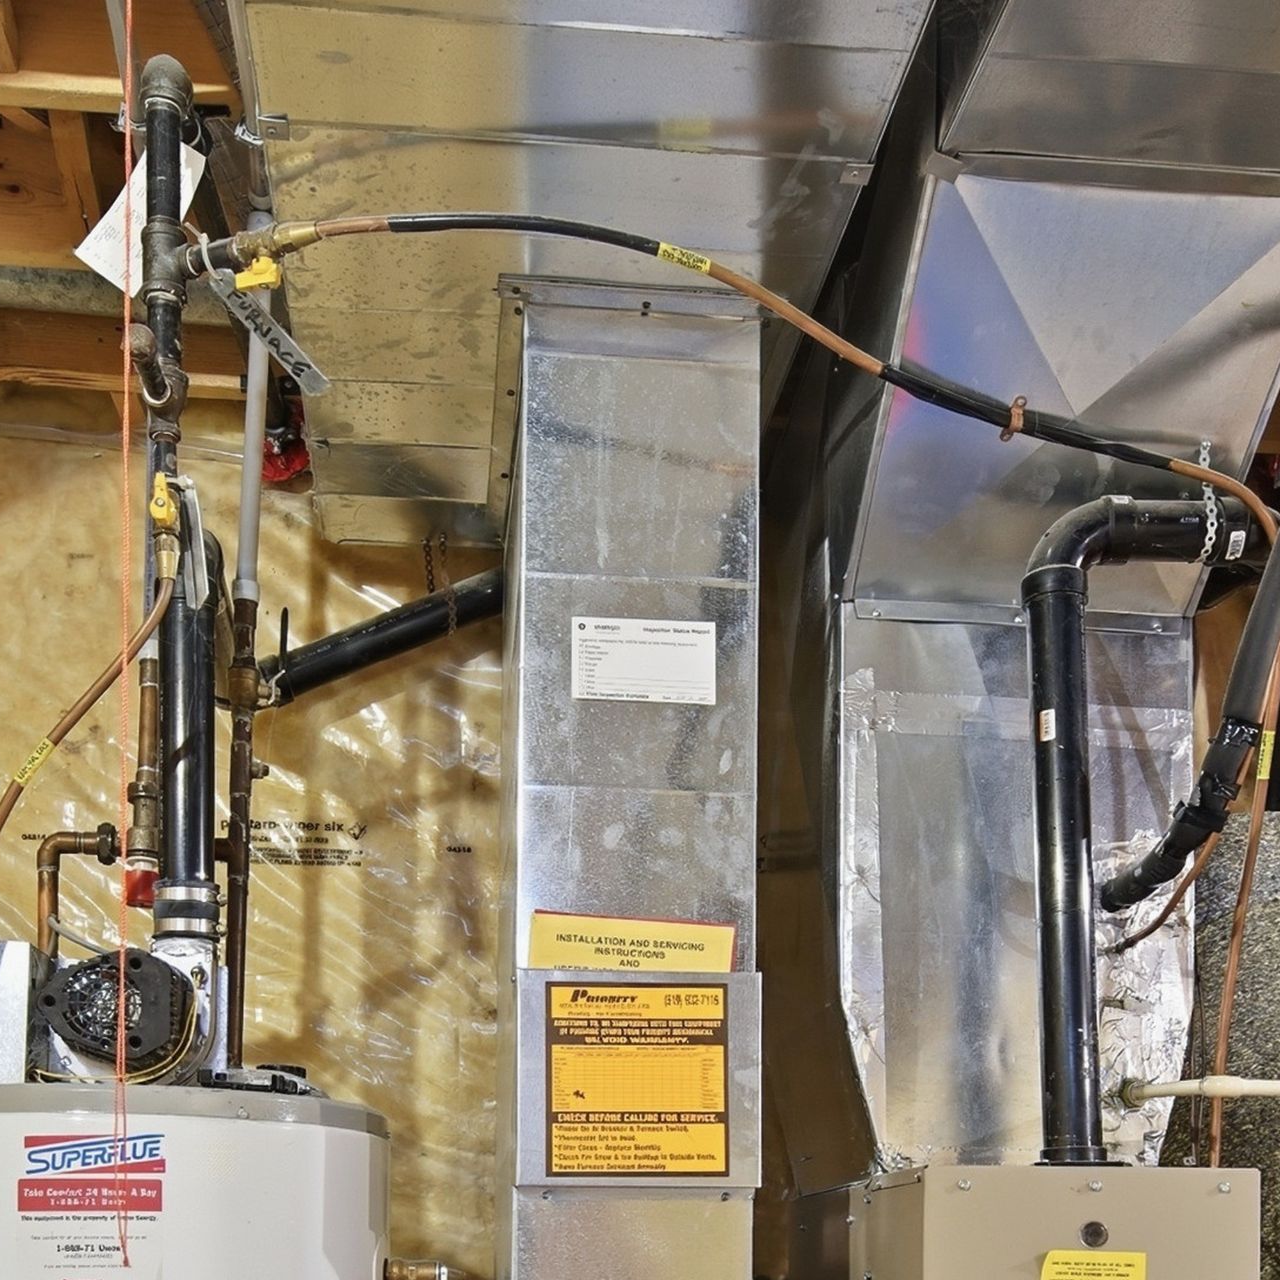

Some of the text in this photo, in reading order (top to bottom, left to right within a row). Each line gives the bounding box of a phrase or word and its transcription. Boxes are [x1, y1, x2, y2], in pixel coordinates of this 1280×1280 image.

[226, 290, 312, 378] FURNACE
[324, 819, 344, 832] six
[555, 933, 705, 952] INSTALLATION AND SERVICING
[593, 947, 666, 960] INSTRUCTIONS
[618, 959, 641, 969] AND
[25, 1134, 166, 1175] SUPERFLUE
